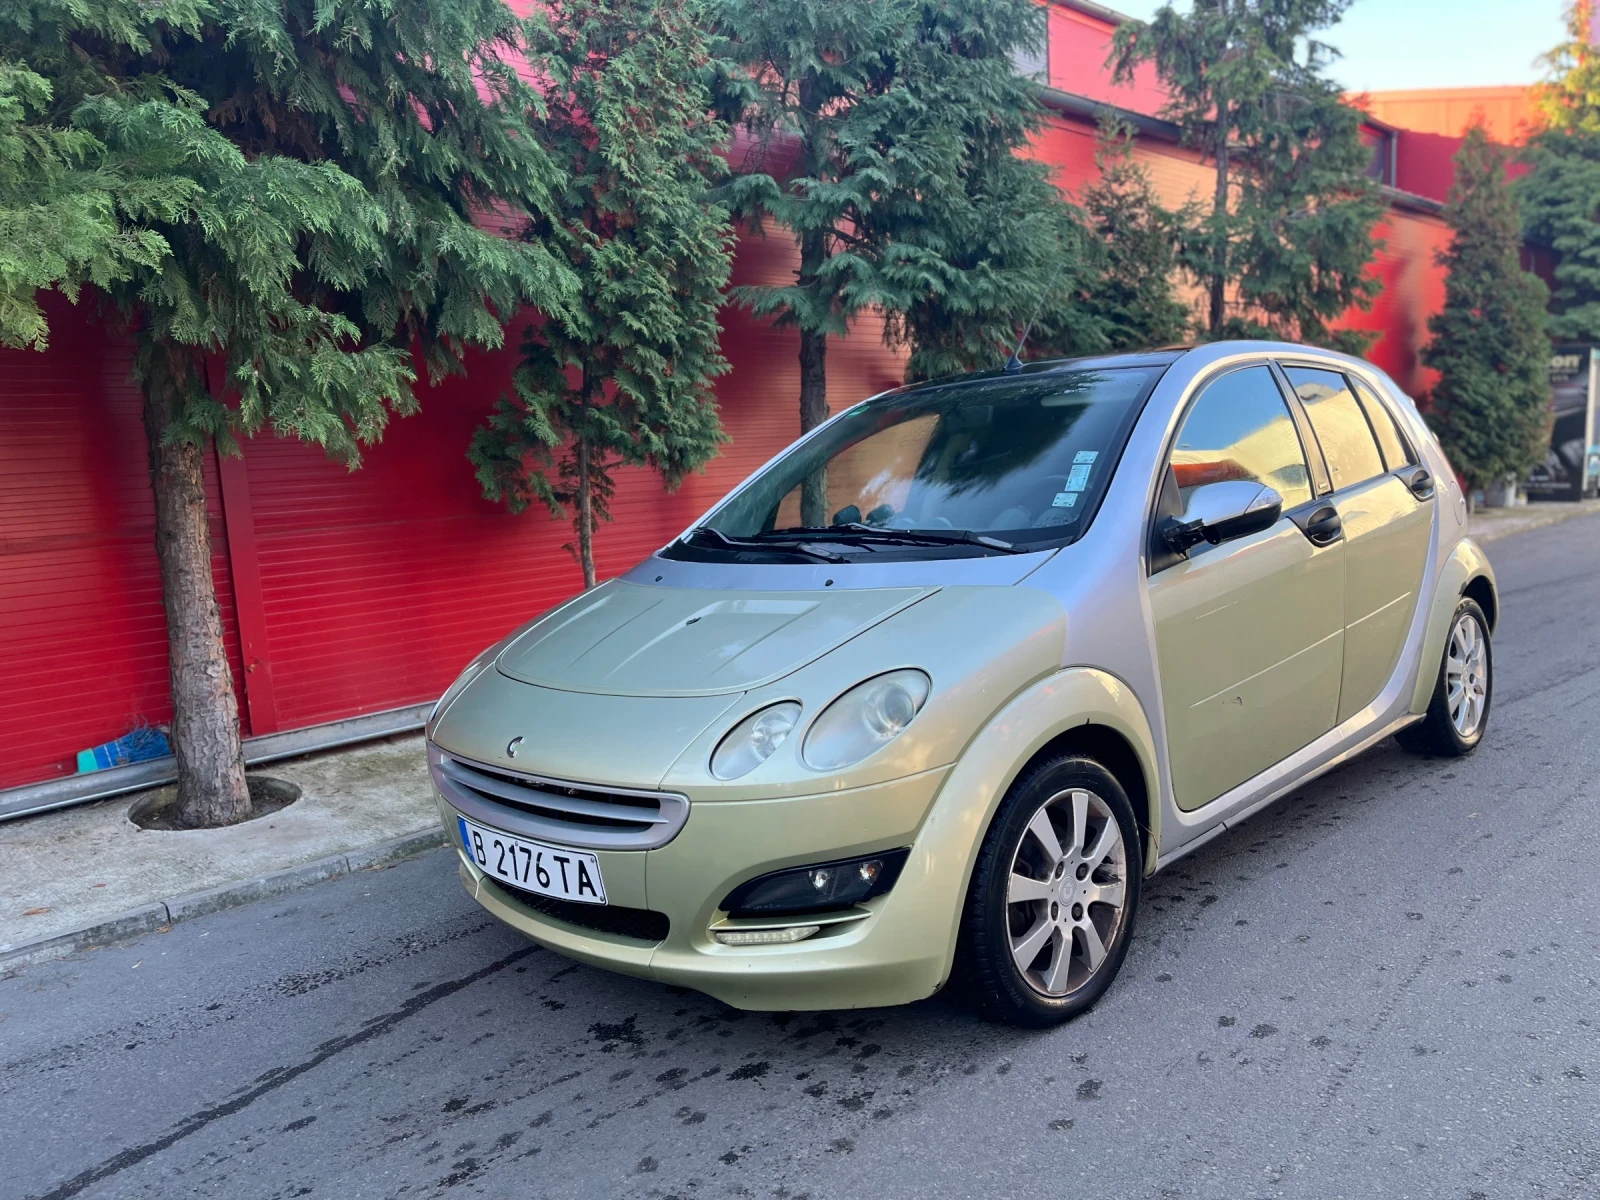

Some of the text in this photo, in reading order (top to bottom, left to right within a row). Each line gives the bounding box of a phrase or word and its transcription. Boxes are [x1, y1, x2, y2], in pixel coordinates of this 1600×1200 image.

[472, 830, 598, 897] B 2176 TA
